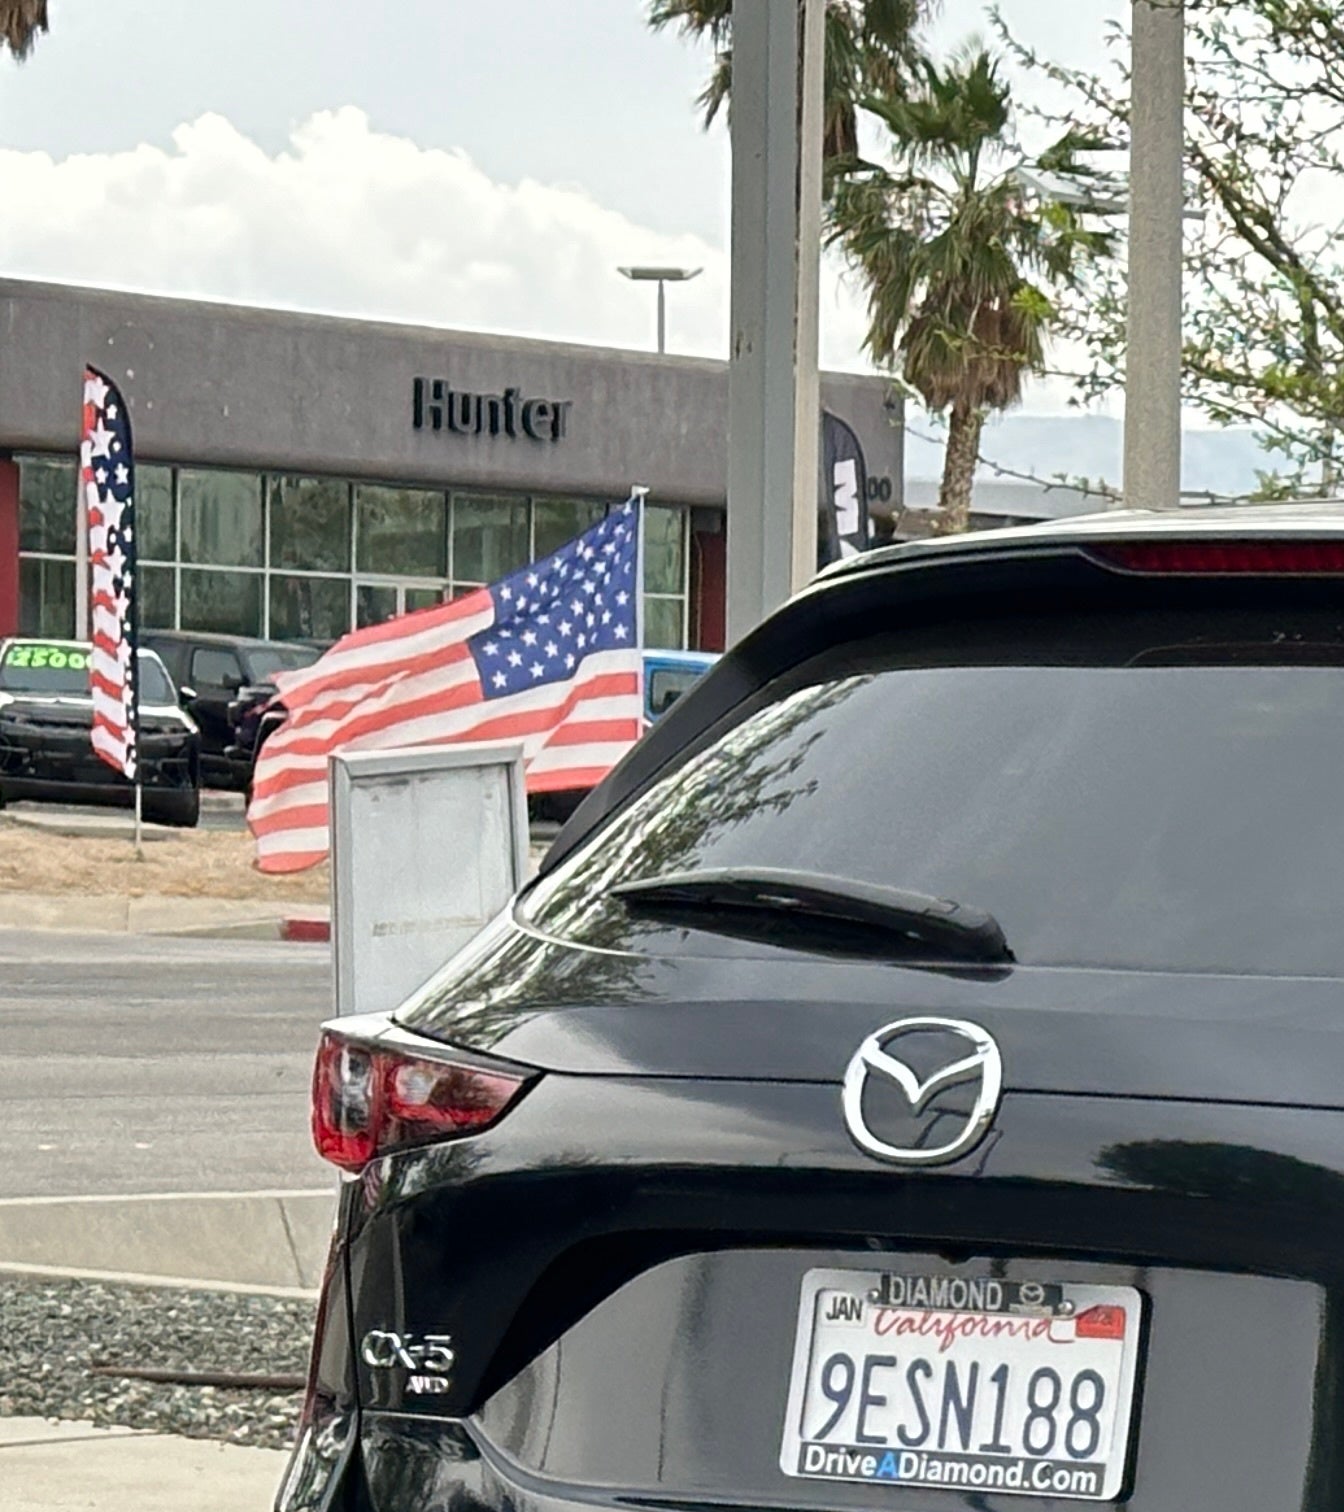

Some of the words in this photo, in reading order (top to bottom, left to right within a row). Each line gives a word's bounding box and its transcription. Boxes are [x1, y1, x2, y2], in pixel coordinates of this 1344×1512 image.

[413, 376, 573, 444] Hunter
[825, 1296, 862, 1321] JAN
[888, 1274, 1003, 1311] DIAMOND
[361, 1329, 455, 1372] CX-5
[874, 1307, 1076, 1353] California
[813, 1351, 1106, 1460] 9ESN188
[803, 1444, 1098, 1494] DriveADiamond.Com
